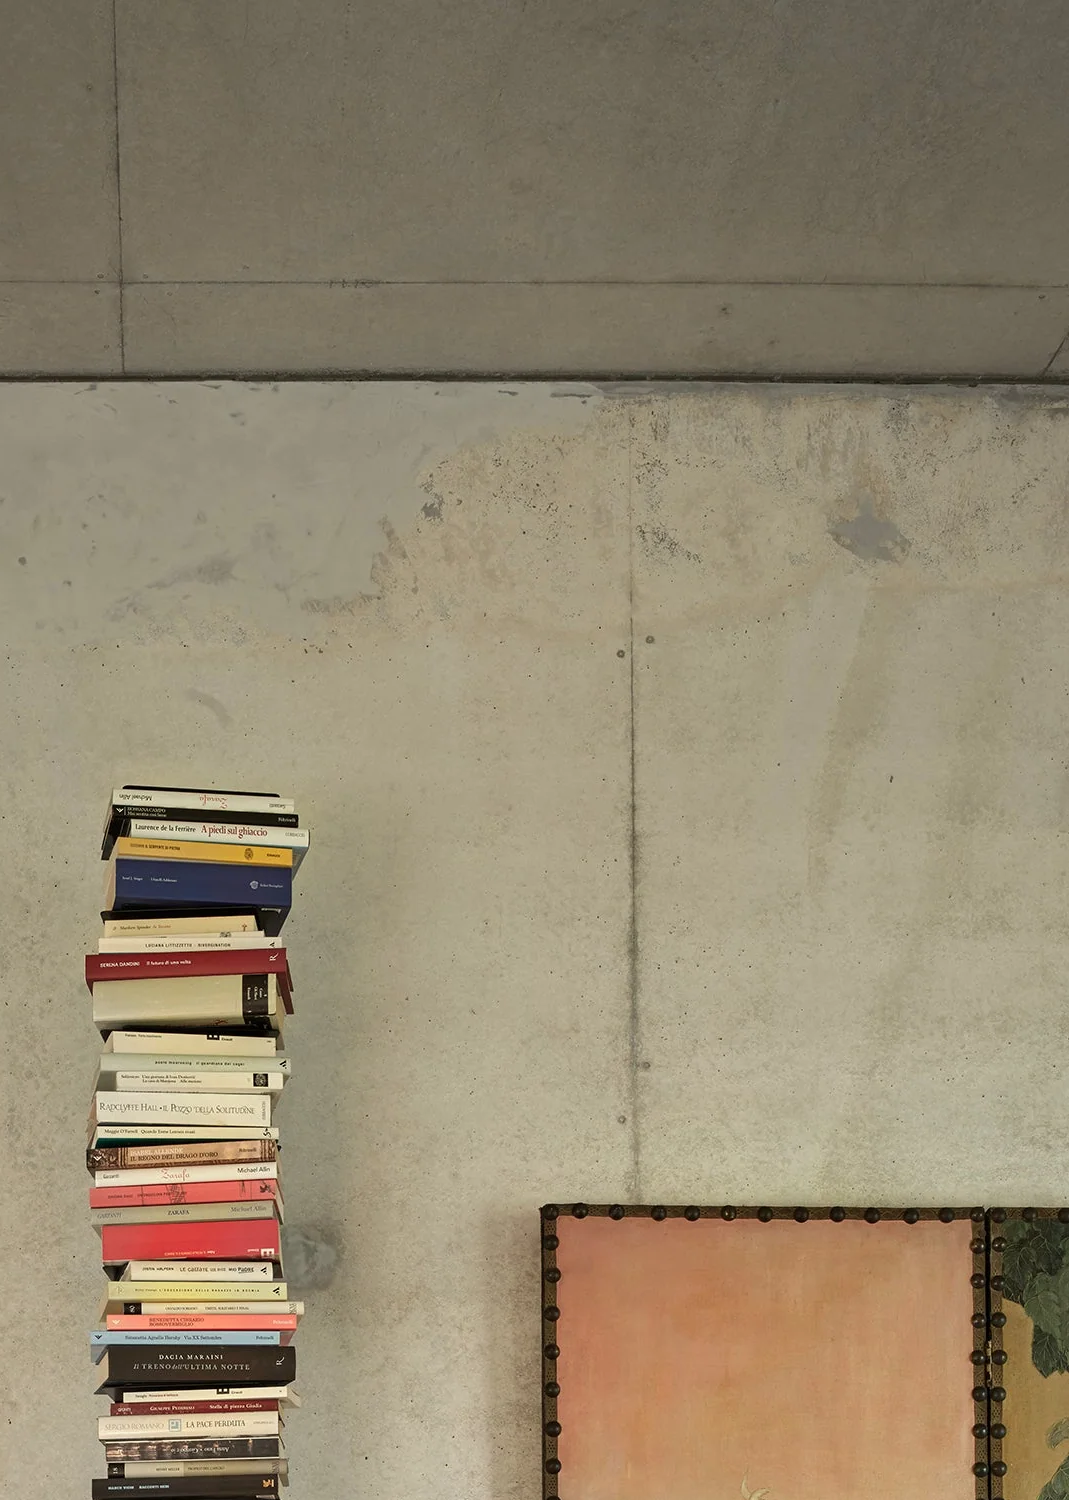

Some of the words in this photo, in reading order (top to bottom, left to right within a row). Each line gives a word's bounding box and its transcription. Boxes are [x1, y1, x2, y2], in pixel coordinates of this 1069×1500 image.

[201, 825, 207, 833] A
[208, 826, 226, 837] piedi
[227, 827, 237, 835] sul
[238, 827, 268, 839] ghiaccio
[141, 1103, 159, 1112] HALL
[170, 1103, 193, 1115] POZZO
[215, 1419, 246, 1427] PERDUTA
